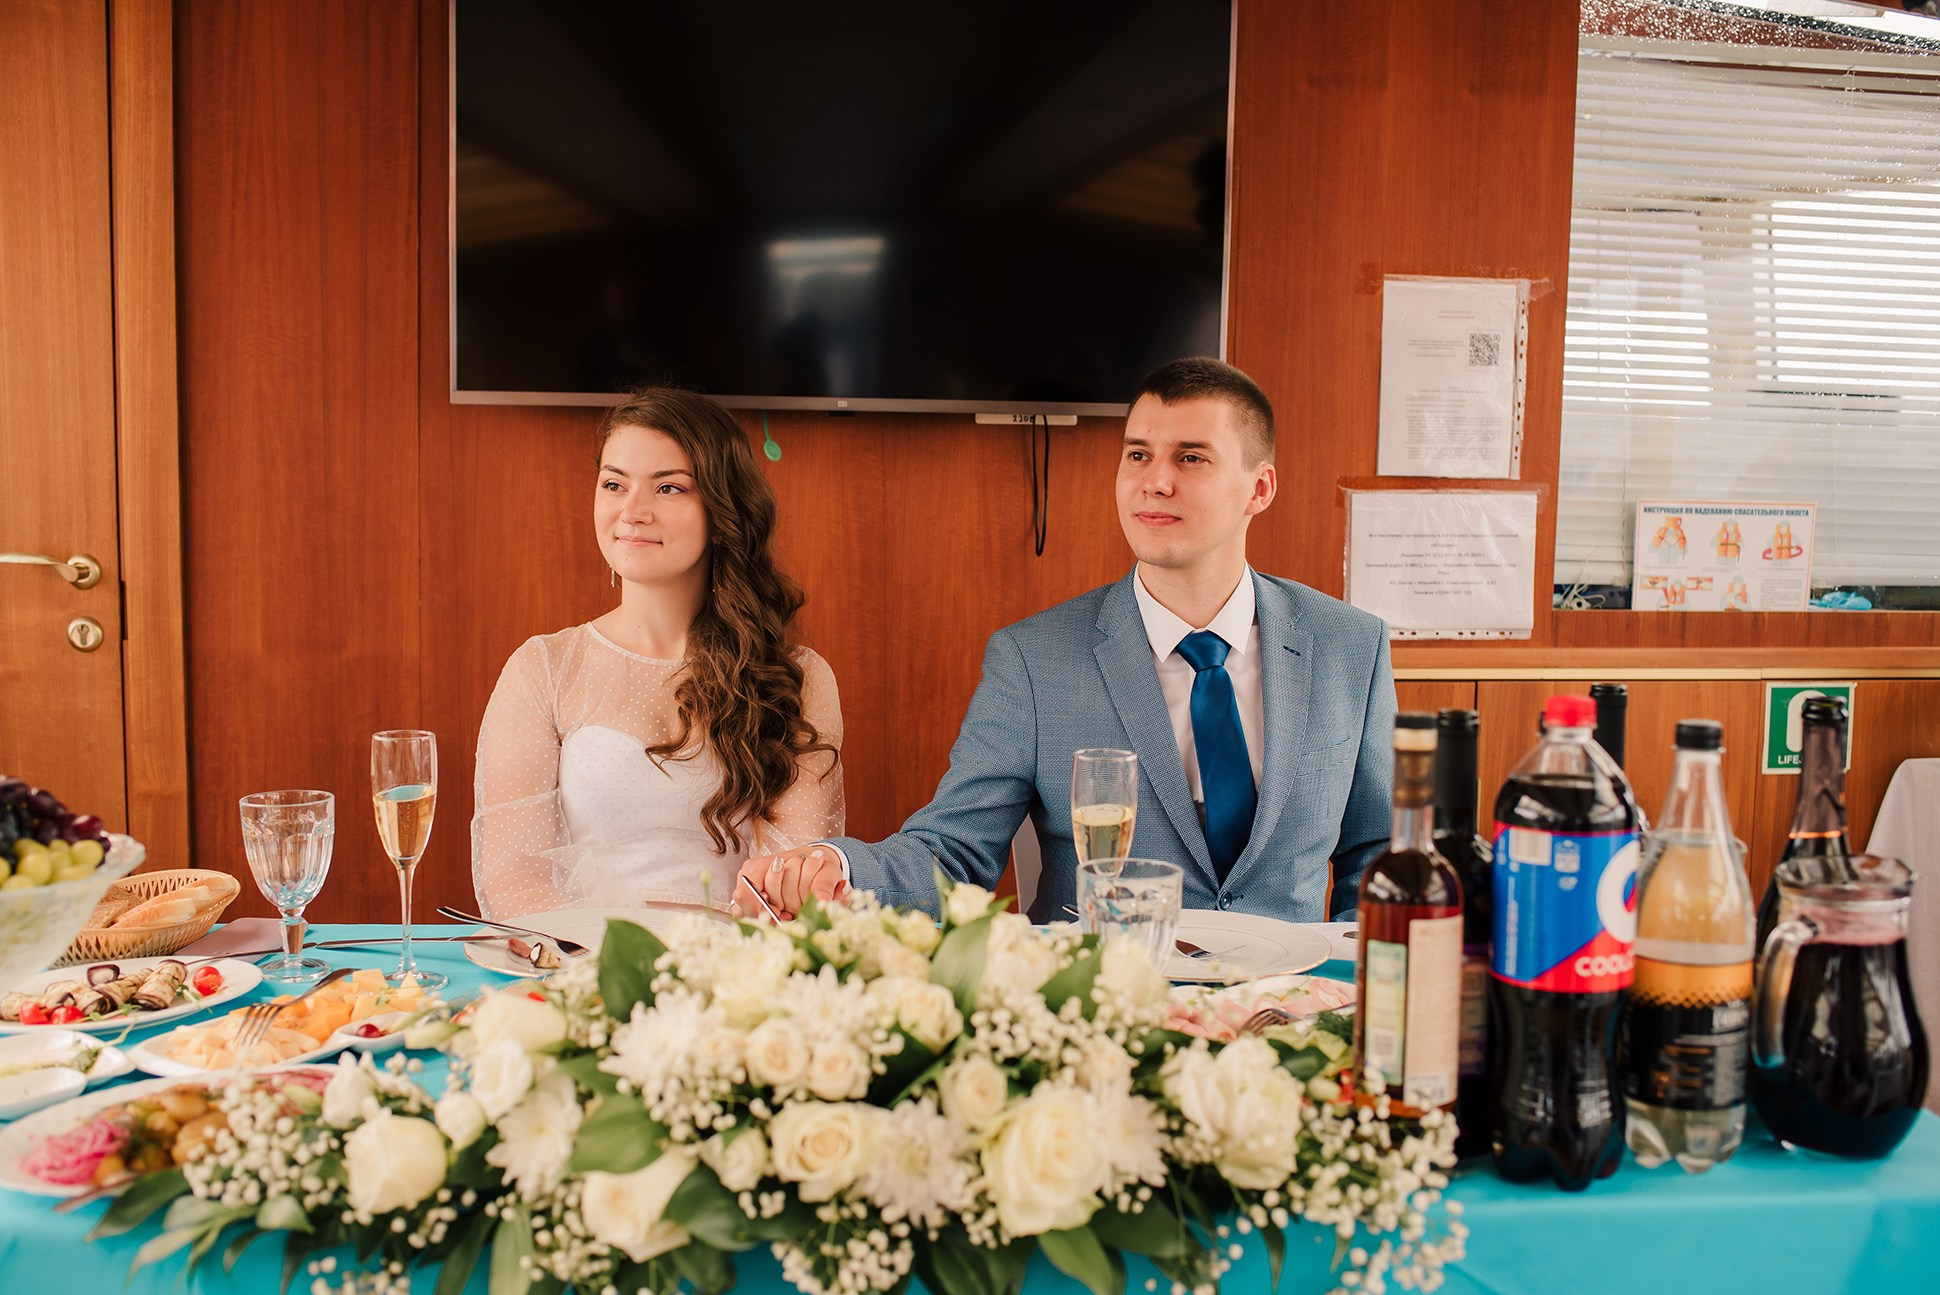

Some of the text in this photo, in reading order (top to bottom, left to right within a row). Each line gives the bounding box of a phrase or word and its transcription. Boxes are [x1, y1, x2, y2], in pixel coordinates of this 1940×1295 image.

[1643, 506, 1684, 514] ИНСТРУКЦИЯ
[1695, 507, 1733, 515] НАДЕВАНИЮ
[1734, 508, 1784, 516] СПАСАТЕЛЬНОГО
